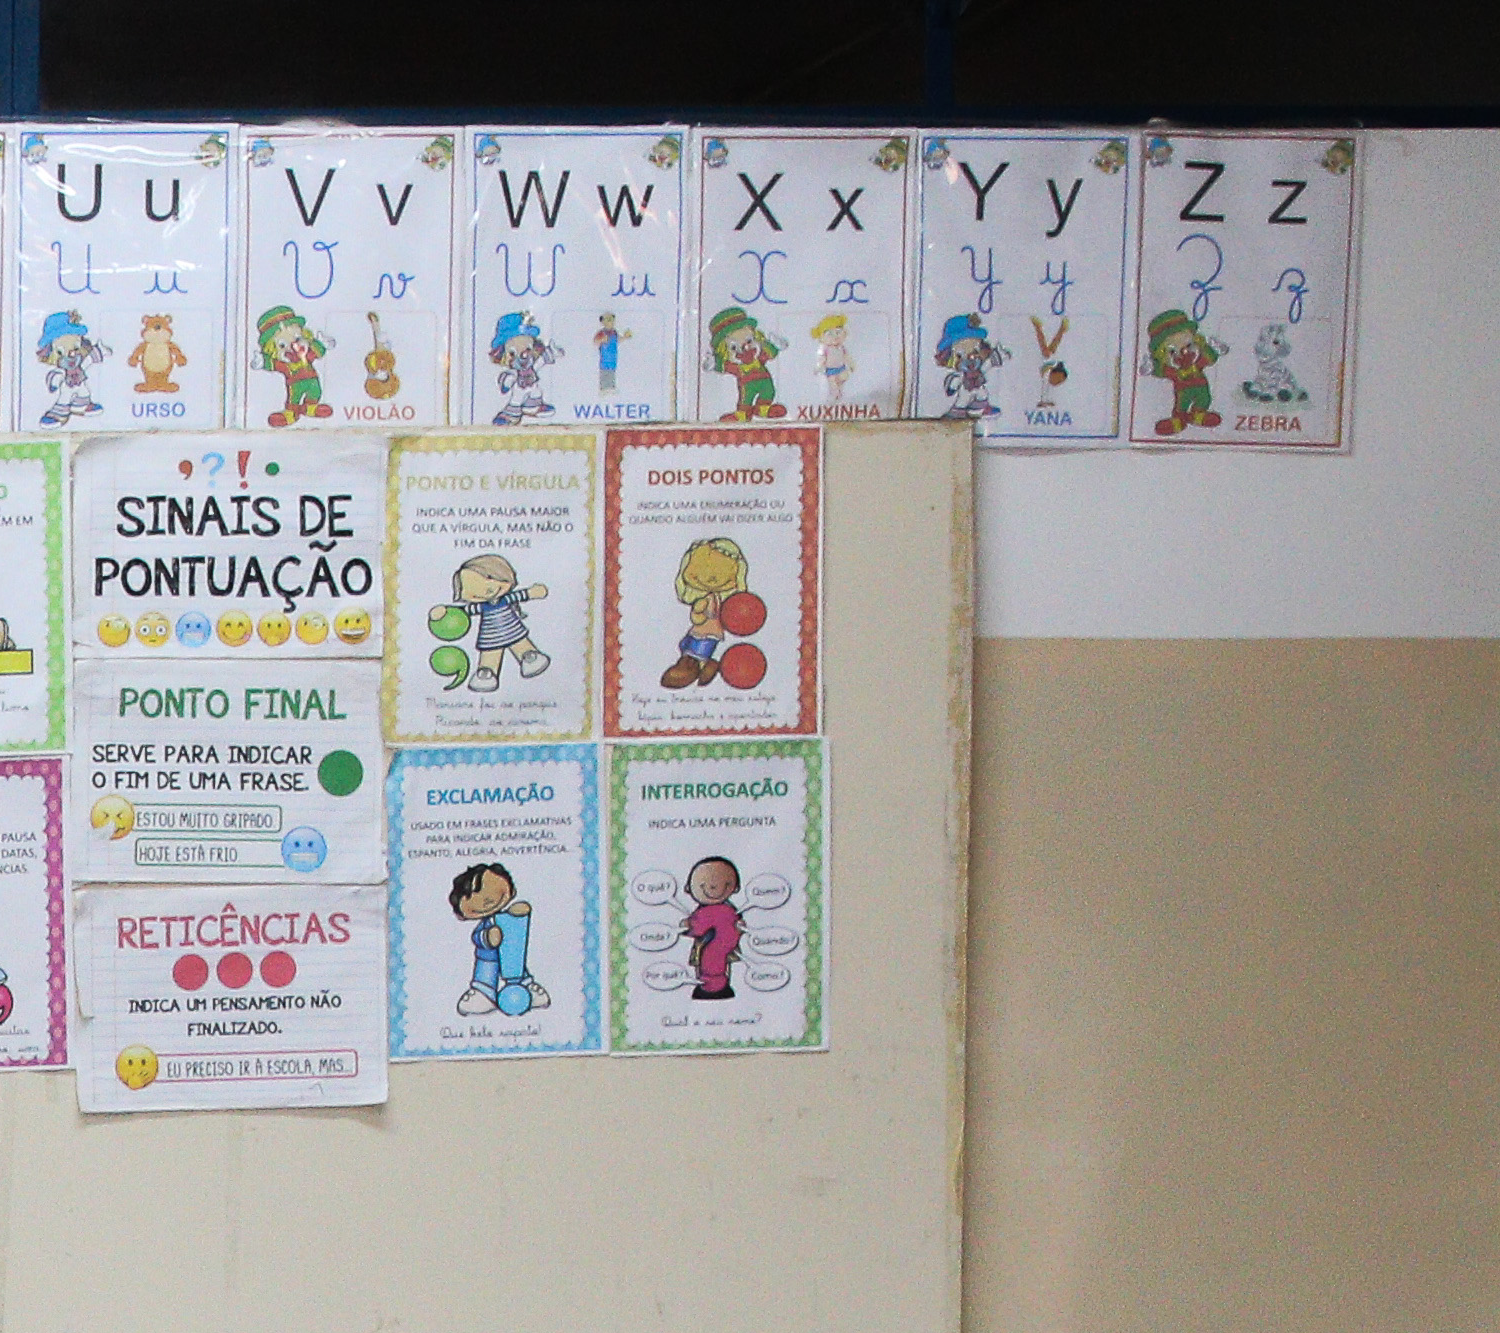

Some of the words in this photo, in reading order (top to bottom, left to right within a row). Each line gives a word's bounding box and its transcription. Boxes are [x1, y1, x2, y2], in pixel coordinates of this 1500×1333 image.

[57, 164, 102, 222] U
[144, 179, 180, 222] u
[286, 167, 336, 226] V
[377, 184, 413, 226] v
[500, 170, 570, 228] W
[597, 185, 653, 227] w
[734, 173, 783, 231] X
[826, 188, 864, 231] x
[959, 162, 1009, 220] Y
[1046, 178, 1083, 238] y
[1179, 162, 1225, 222] Z
[1268, 181, 1307, 224] z
[131, 402, 185, 418] URSO
[344, 402, 415, 421] VIOLÃO
[574, 403, 649, 419] WALTER
[797, 404, 880, 419] XUXINHA
[1024, 410, 1072, 426] YANA
[1235, 414, 1300, 431] ZEBRA
[407, 476, 473, 490] PONTO
[481, 476, 490, 489] E
[498, 469, 579, 490] VÍRGULA
[648, 470, 692, 485] DOIS
[699, 469, 774, 484] PONTOS
[16, 516, 33, 525] EM
[116, 495, 280, 537] SINAIS
[299, 495, 353, 537] DE
[95, 540, 373, 613] PONTUAÇÃO
[119, 688, 230, 718] PONTO
[245, 689, 347, 720] FINAL
[92, 744, 155, 763] SERVE
[165, 745, 220, 763] PARA
[228, 745, 312, 764] INDICAR
[92, 774, 105, 788] O
[115, 772, 149, 788] FIM
[157, 772, 181, 789] DE
[190, 773, 231, 790] UMA
[240, 773, 309, 791] FRASE.
[642, 778, 788, 801] INTERROGAÇÃO
[427, 783, 554, 806] EXCLAMAÇÃO
[137, 812, 175, 827] ESTOU
[180, 813, 218, 827] MUITO
[649, 820, 686, 829] INDICA
[689, 818, 716, 828] UMA
[720, 816, 776, 827] PERGUNTA
[140, 847, 171, 861] HOJE
[117, 903, 350, 949] RETICÊNCIAS
[129, 1000, 180, 1013] INDICA
[187, 1000, 206, 1011] UM
[213, 995, 304, 1011] PENSAMENTO
[311, 990, 341, 1009] NÃO
[188, 1021, 282, 1036] FINALIZADO.
[167, 1064, 179, 1078] EU
[186, 1062, 233, 1077] PRECISO
[240, 1061, 249, 1076] IR
